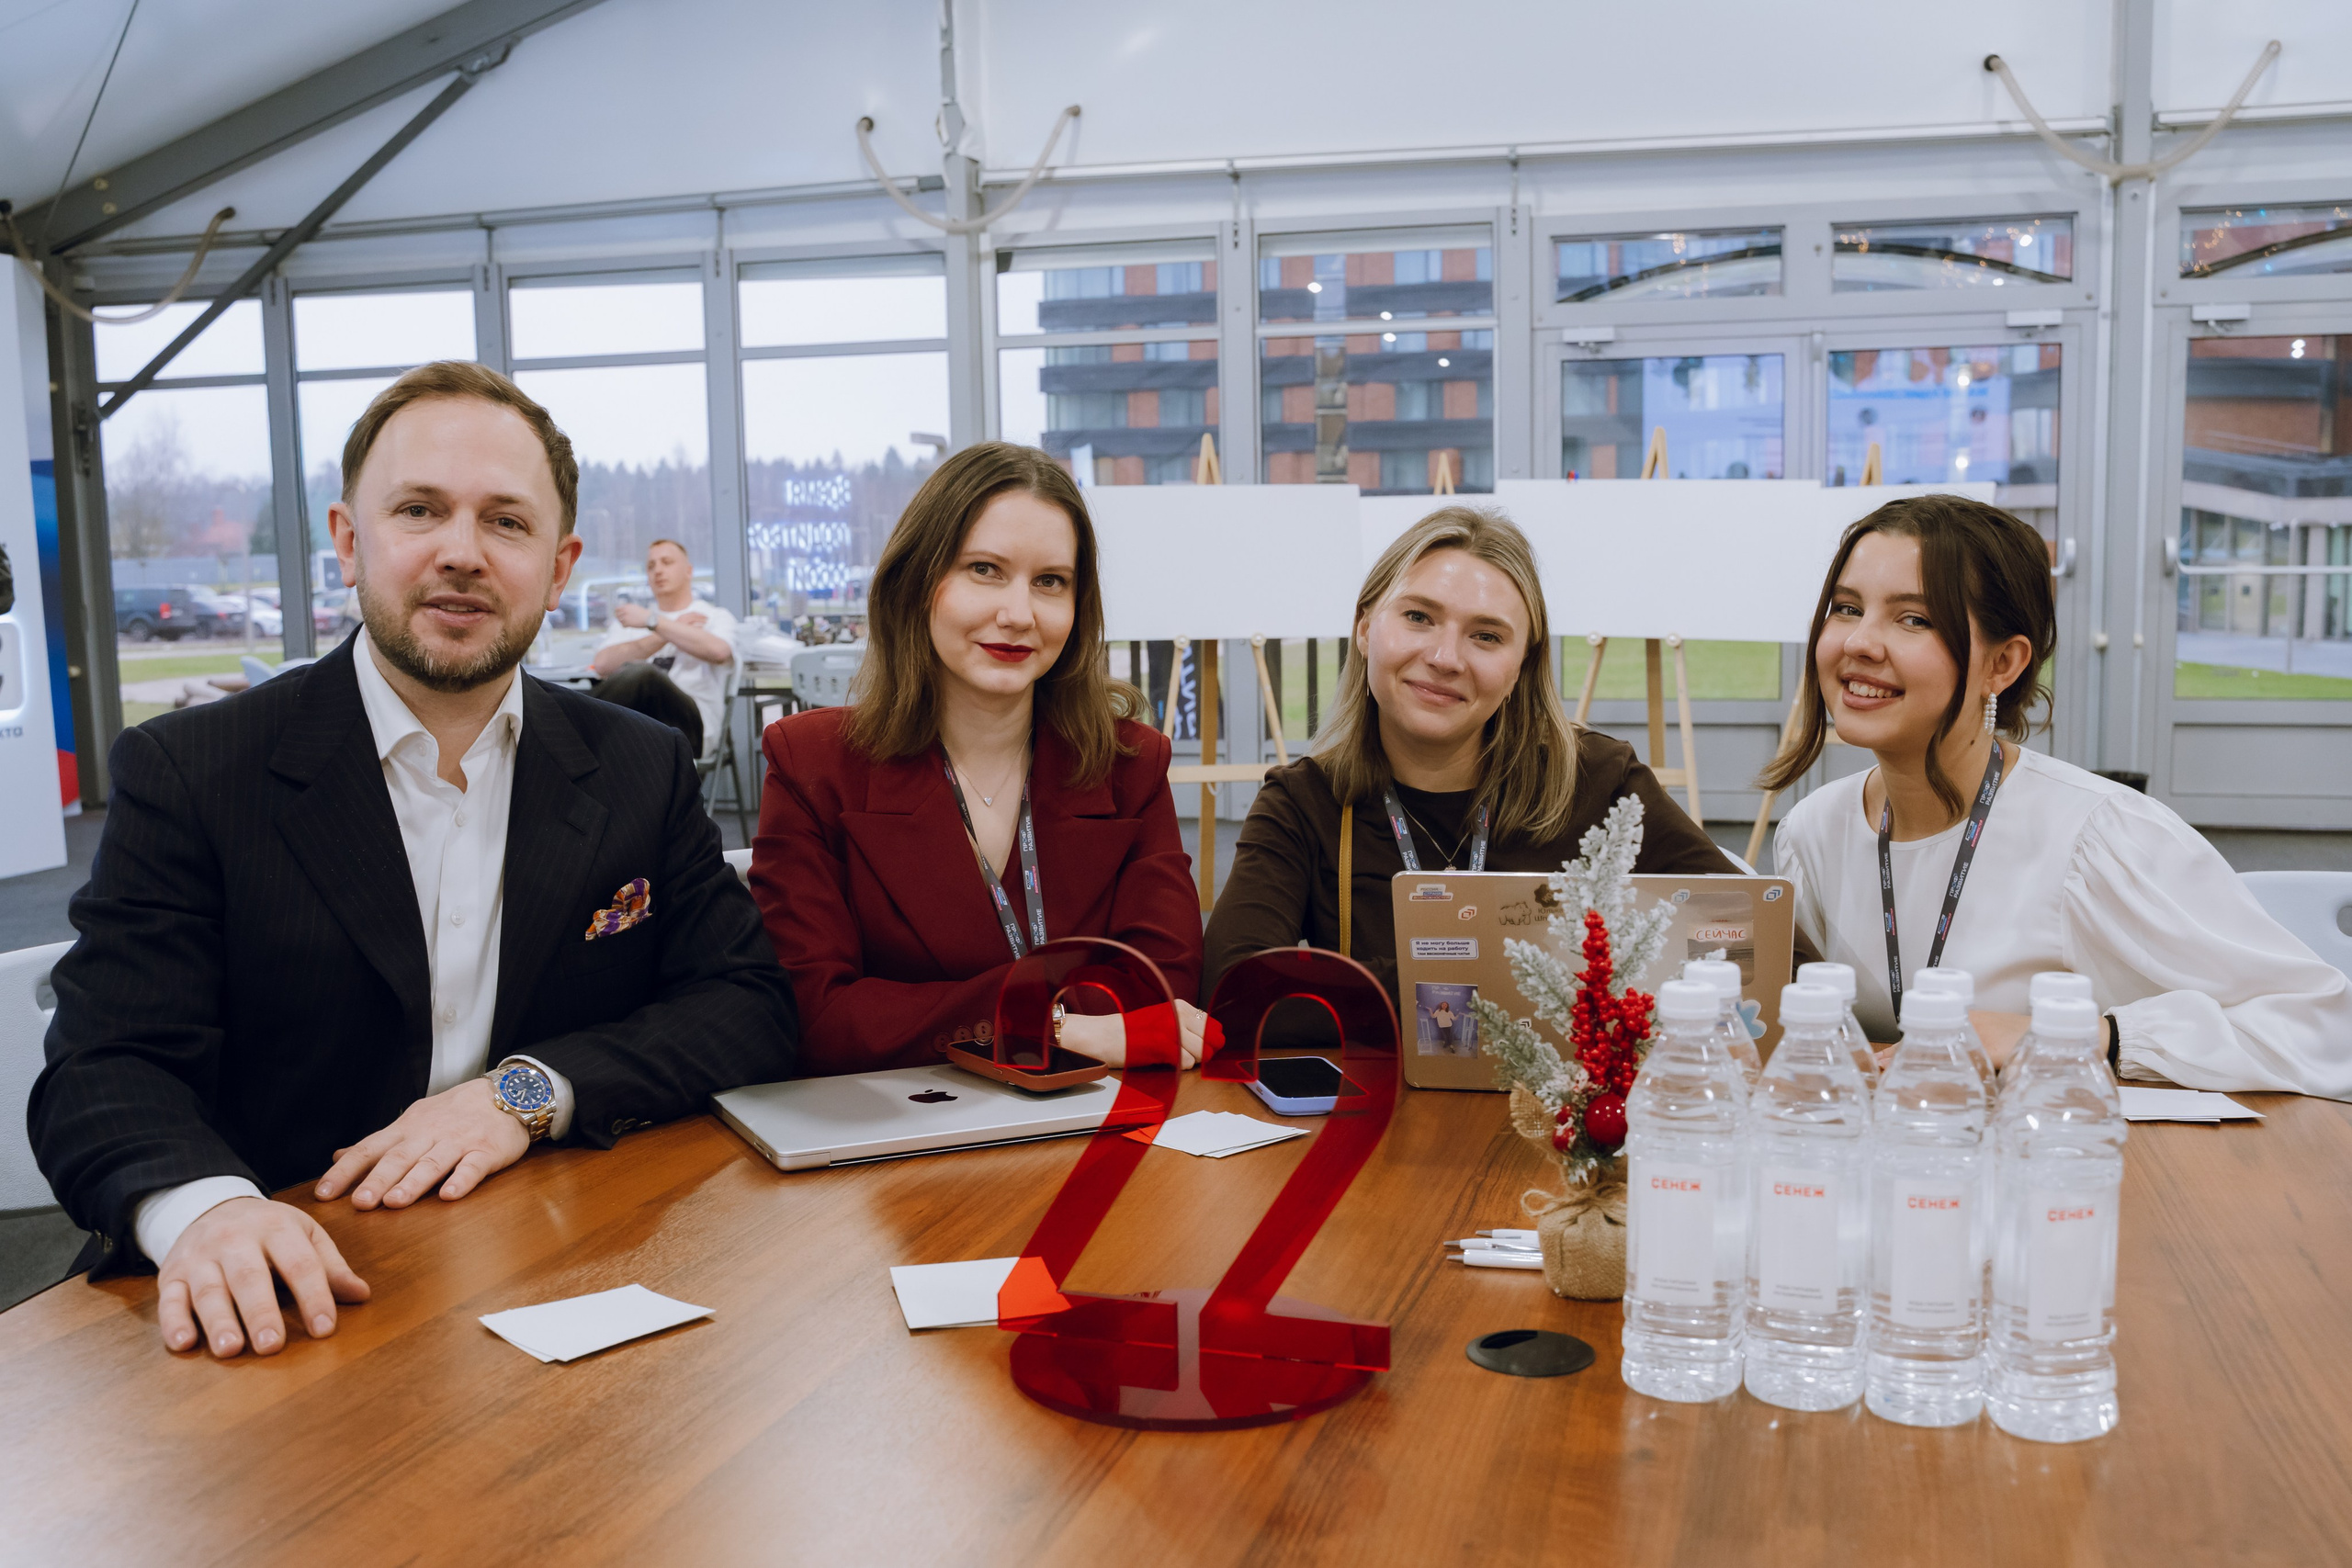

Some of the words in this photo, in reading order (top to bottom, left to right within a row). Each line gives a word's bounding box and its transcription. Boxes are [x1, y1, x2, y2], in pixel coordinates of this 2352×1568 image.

[1985, 772, 2000, 806] РАЗВИТИЕ
[1025, 816, 1034, 852] РАЗВИТИЕ
[1954, 862, 1968, 898] РАЗВИТИЕ
[1005, 924, 1022, 960] РАЗВИТИЕ
[1036, 908, 1046, 945] РАЗВИТИЕ
[1696, 928, 1746, 940] СЕЙЧАС
[1651, 1178, 1701, 1191] СЕНЕЖ
[1774, 1183, 1825, 1197] СЕНЕЖ
[1907, 1196, 1960, 1210] СЕНЕЖ
